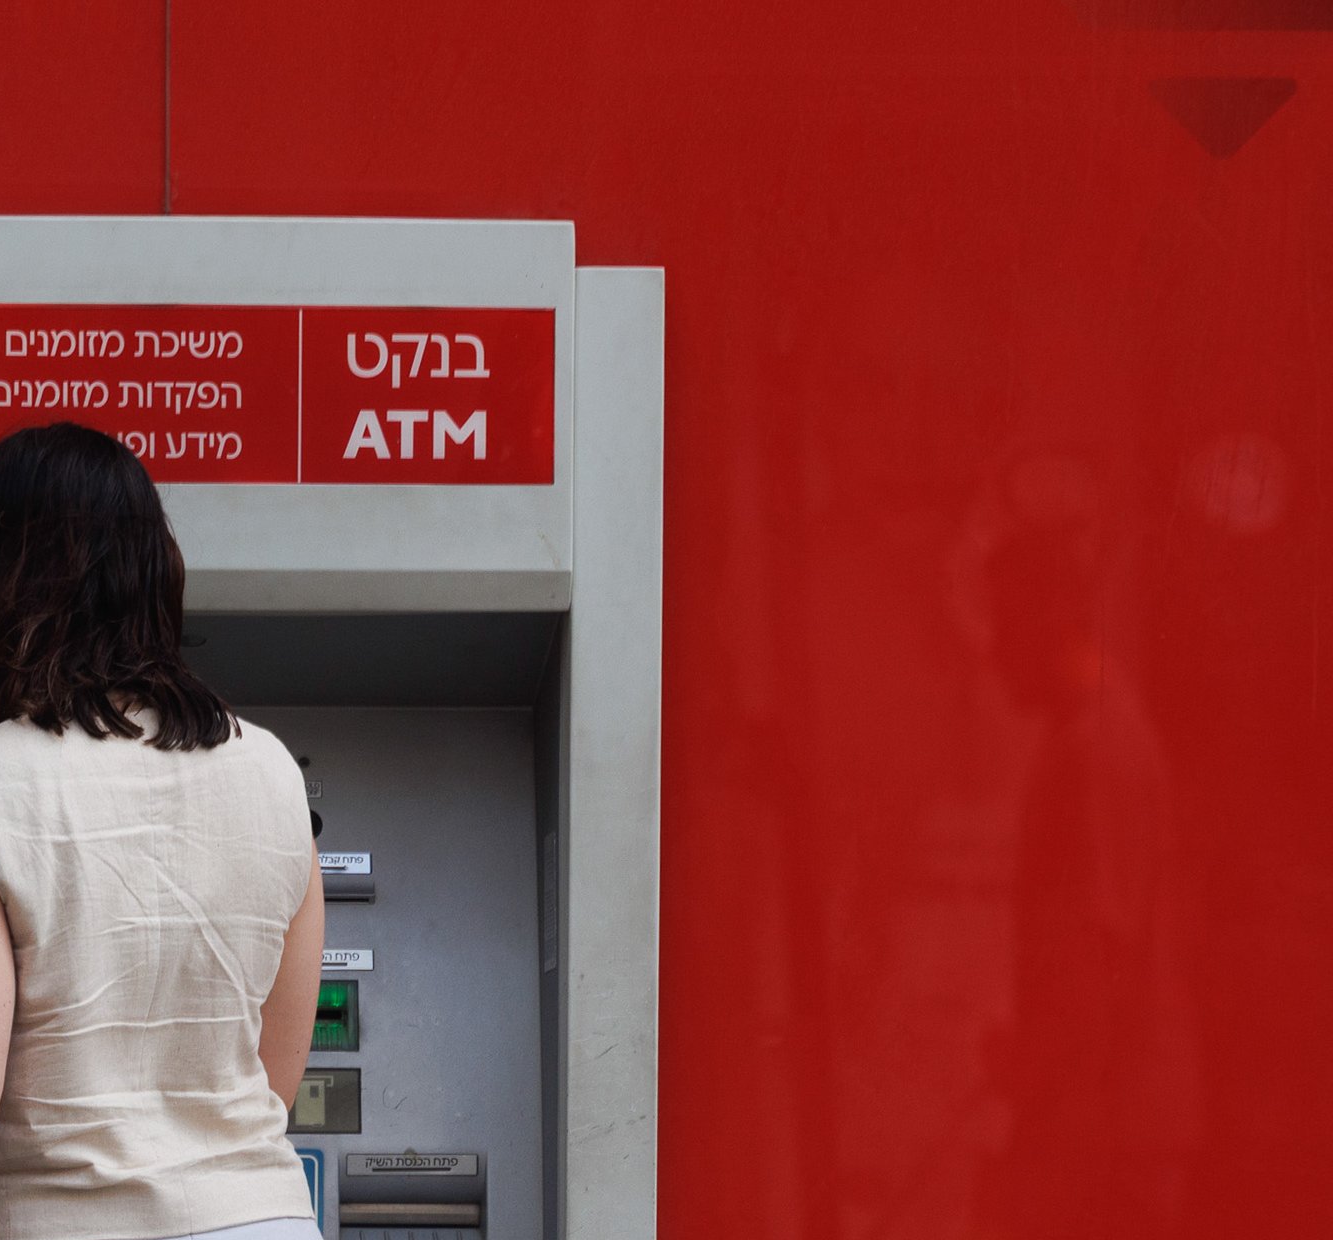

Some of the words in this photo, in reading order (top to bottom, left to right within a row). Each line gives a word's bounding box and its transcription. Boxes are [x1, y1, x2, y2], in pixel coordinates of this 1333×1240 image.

[5, 329, 125, 358] מזומנים
[133, 330, 244, 359] משיכת
[346, 332, 491, 388] בנקט
[118, 380, 243, 414] הפקדות
[165, 431, 243, 460] מידע
[342, 409, 488, 460] ATM
[342, 856, 364, 864] פתח
[335, 952, 360, 961] פתח
[365, 1157, 393, 1168] השיק
[396, 1157, 431, 1167] הכנסת
[434, 1158, 459, 1167] פתח
